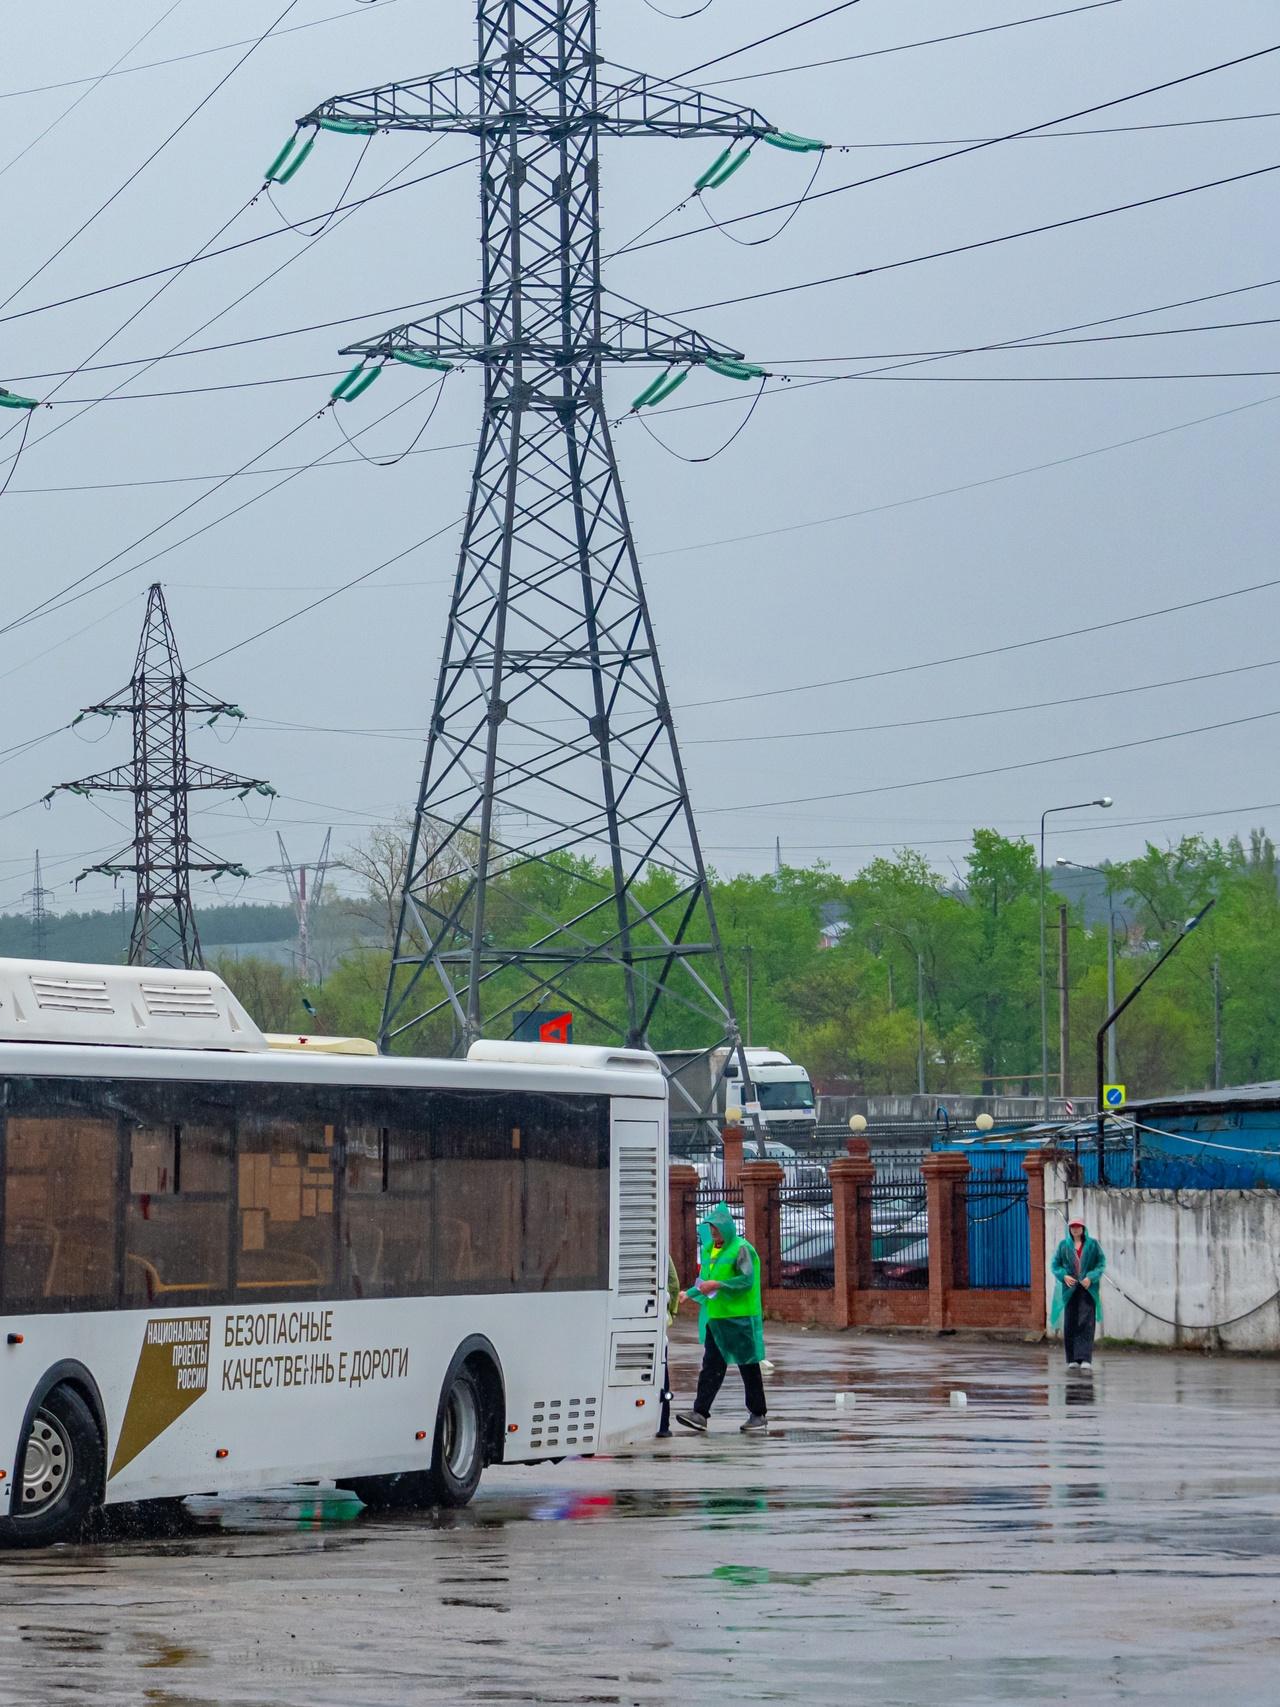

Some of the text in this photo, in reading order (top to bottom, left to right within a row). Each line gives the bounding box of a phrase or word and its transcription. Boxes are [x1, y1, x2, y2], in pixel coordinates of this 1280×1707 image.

[148, 1320, 209, 1346] НАЦИОНАЛЬНЫЕ
[224, 1311, 334, 1347] БЕЗОПАСНЫЕ
[173, 1344, 208, 1366] ПРОЕКТЫ
[349, 1348, 409, 1388] ДОРОГИ
[177, 1367, 207, 1390] РОССИИ
